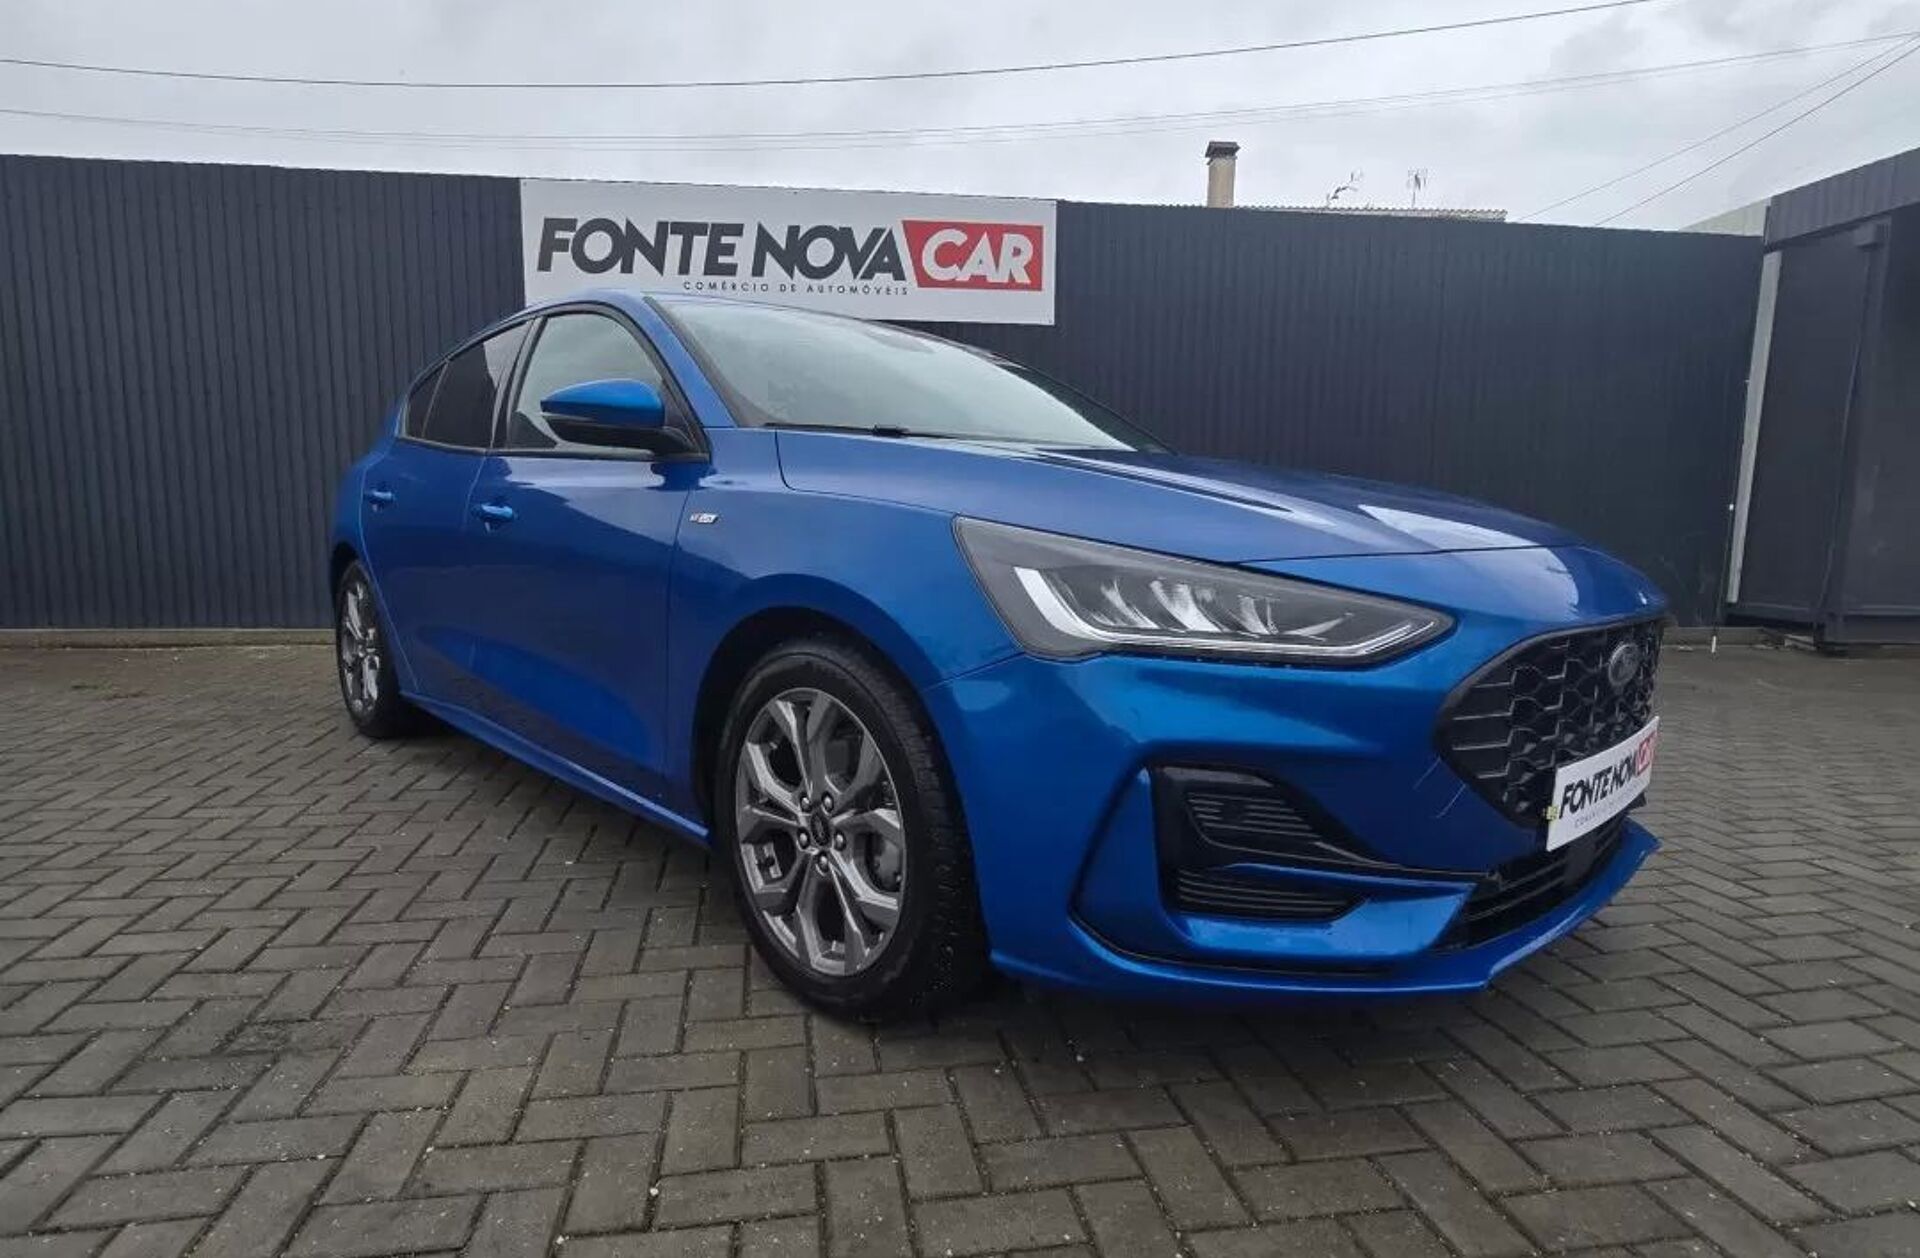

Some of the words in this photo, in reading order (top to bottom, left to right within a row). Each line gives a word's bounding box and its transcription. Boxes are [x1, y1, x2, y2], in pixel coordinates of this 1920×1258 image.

[537, 217, 744, 277] FONTE
[751, 221, 907, 281] NOVA
[921, 228, 1034, 284] CAR
[682, 280, 769, 293] COMÉRCIO
[779, 283, 797, 293] DE
[806, 283, 909, 296] AUTOMÓVEIS
[1559, 765, 1613, 819] FONTE
